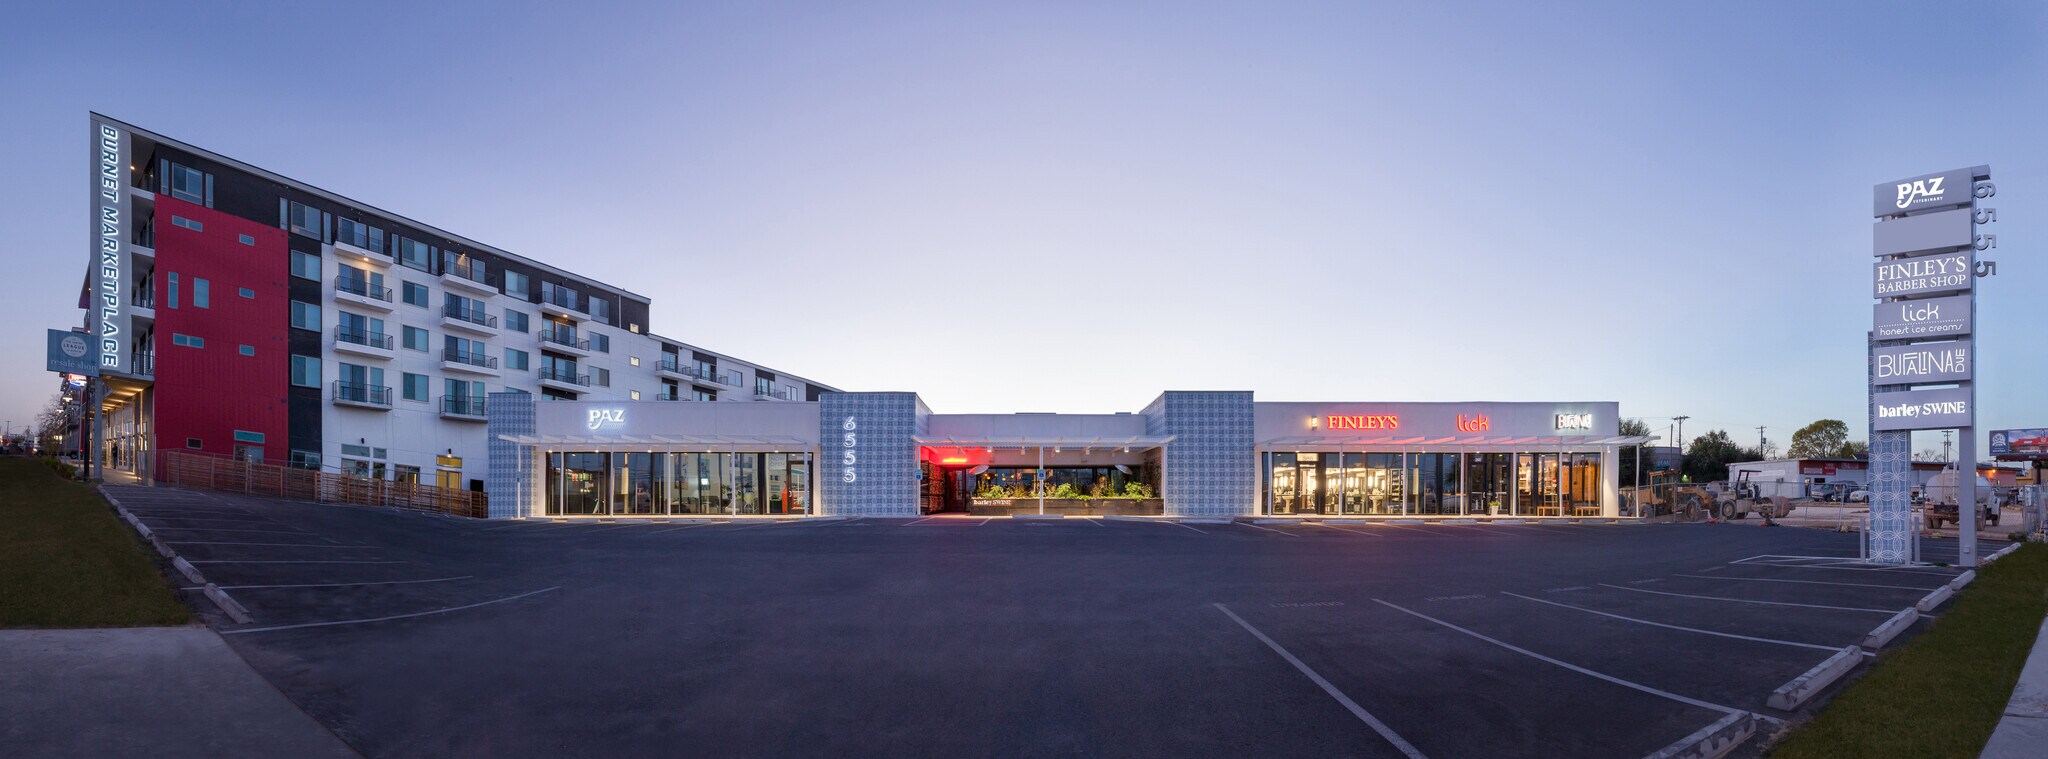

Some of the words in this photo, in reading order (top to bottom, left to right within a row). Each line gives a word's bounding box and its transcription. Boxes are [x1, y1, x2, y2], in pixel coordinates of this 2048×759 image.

[102, 124, 118, 202] BURNET
[1896, 176, 1945, 209] PAZ
[1913, 196, 1944, 204] VETERINARY
[1877, 256, 1967, 282] FINLEY'S
[102, 206, 118, 367] MARKETPLACE
[1877, 278, 1928, 294] BARBER
[1930, 274, 1967, 288] SHOP
[1902, 302, 1939, 322] lick
[1879, 325, 1909, 336] honest
[1911, 324, 1926, 334] ice
[1928, 323, 1963, 333] creams
[50, 359, 75, 368] resale
[77, 361, 97, 372] shop
[1878, 350, 1954, 378] BUFALINA
[1955, 348, 1966, 373] DUE
[589, 409, 625, 430] PAZ
[1878, 403, 1921, 419] barley
[1922, 401, 1966, 416] SWINE
[1328, 415, 1398, 430] FINLEY'S
[1457, 413, 1488, 432] lick
[843, 415, 856, 483] 6555
